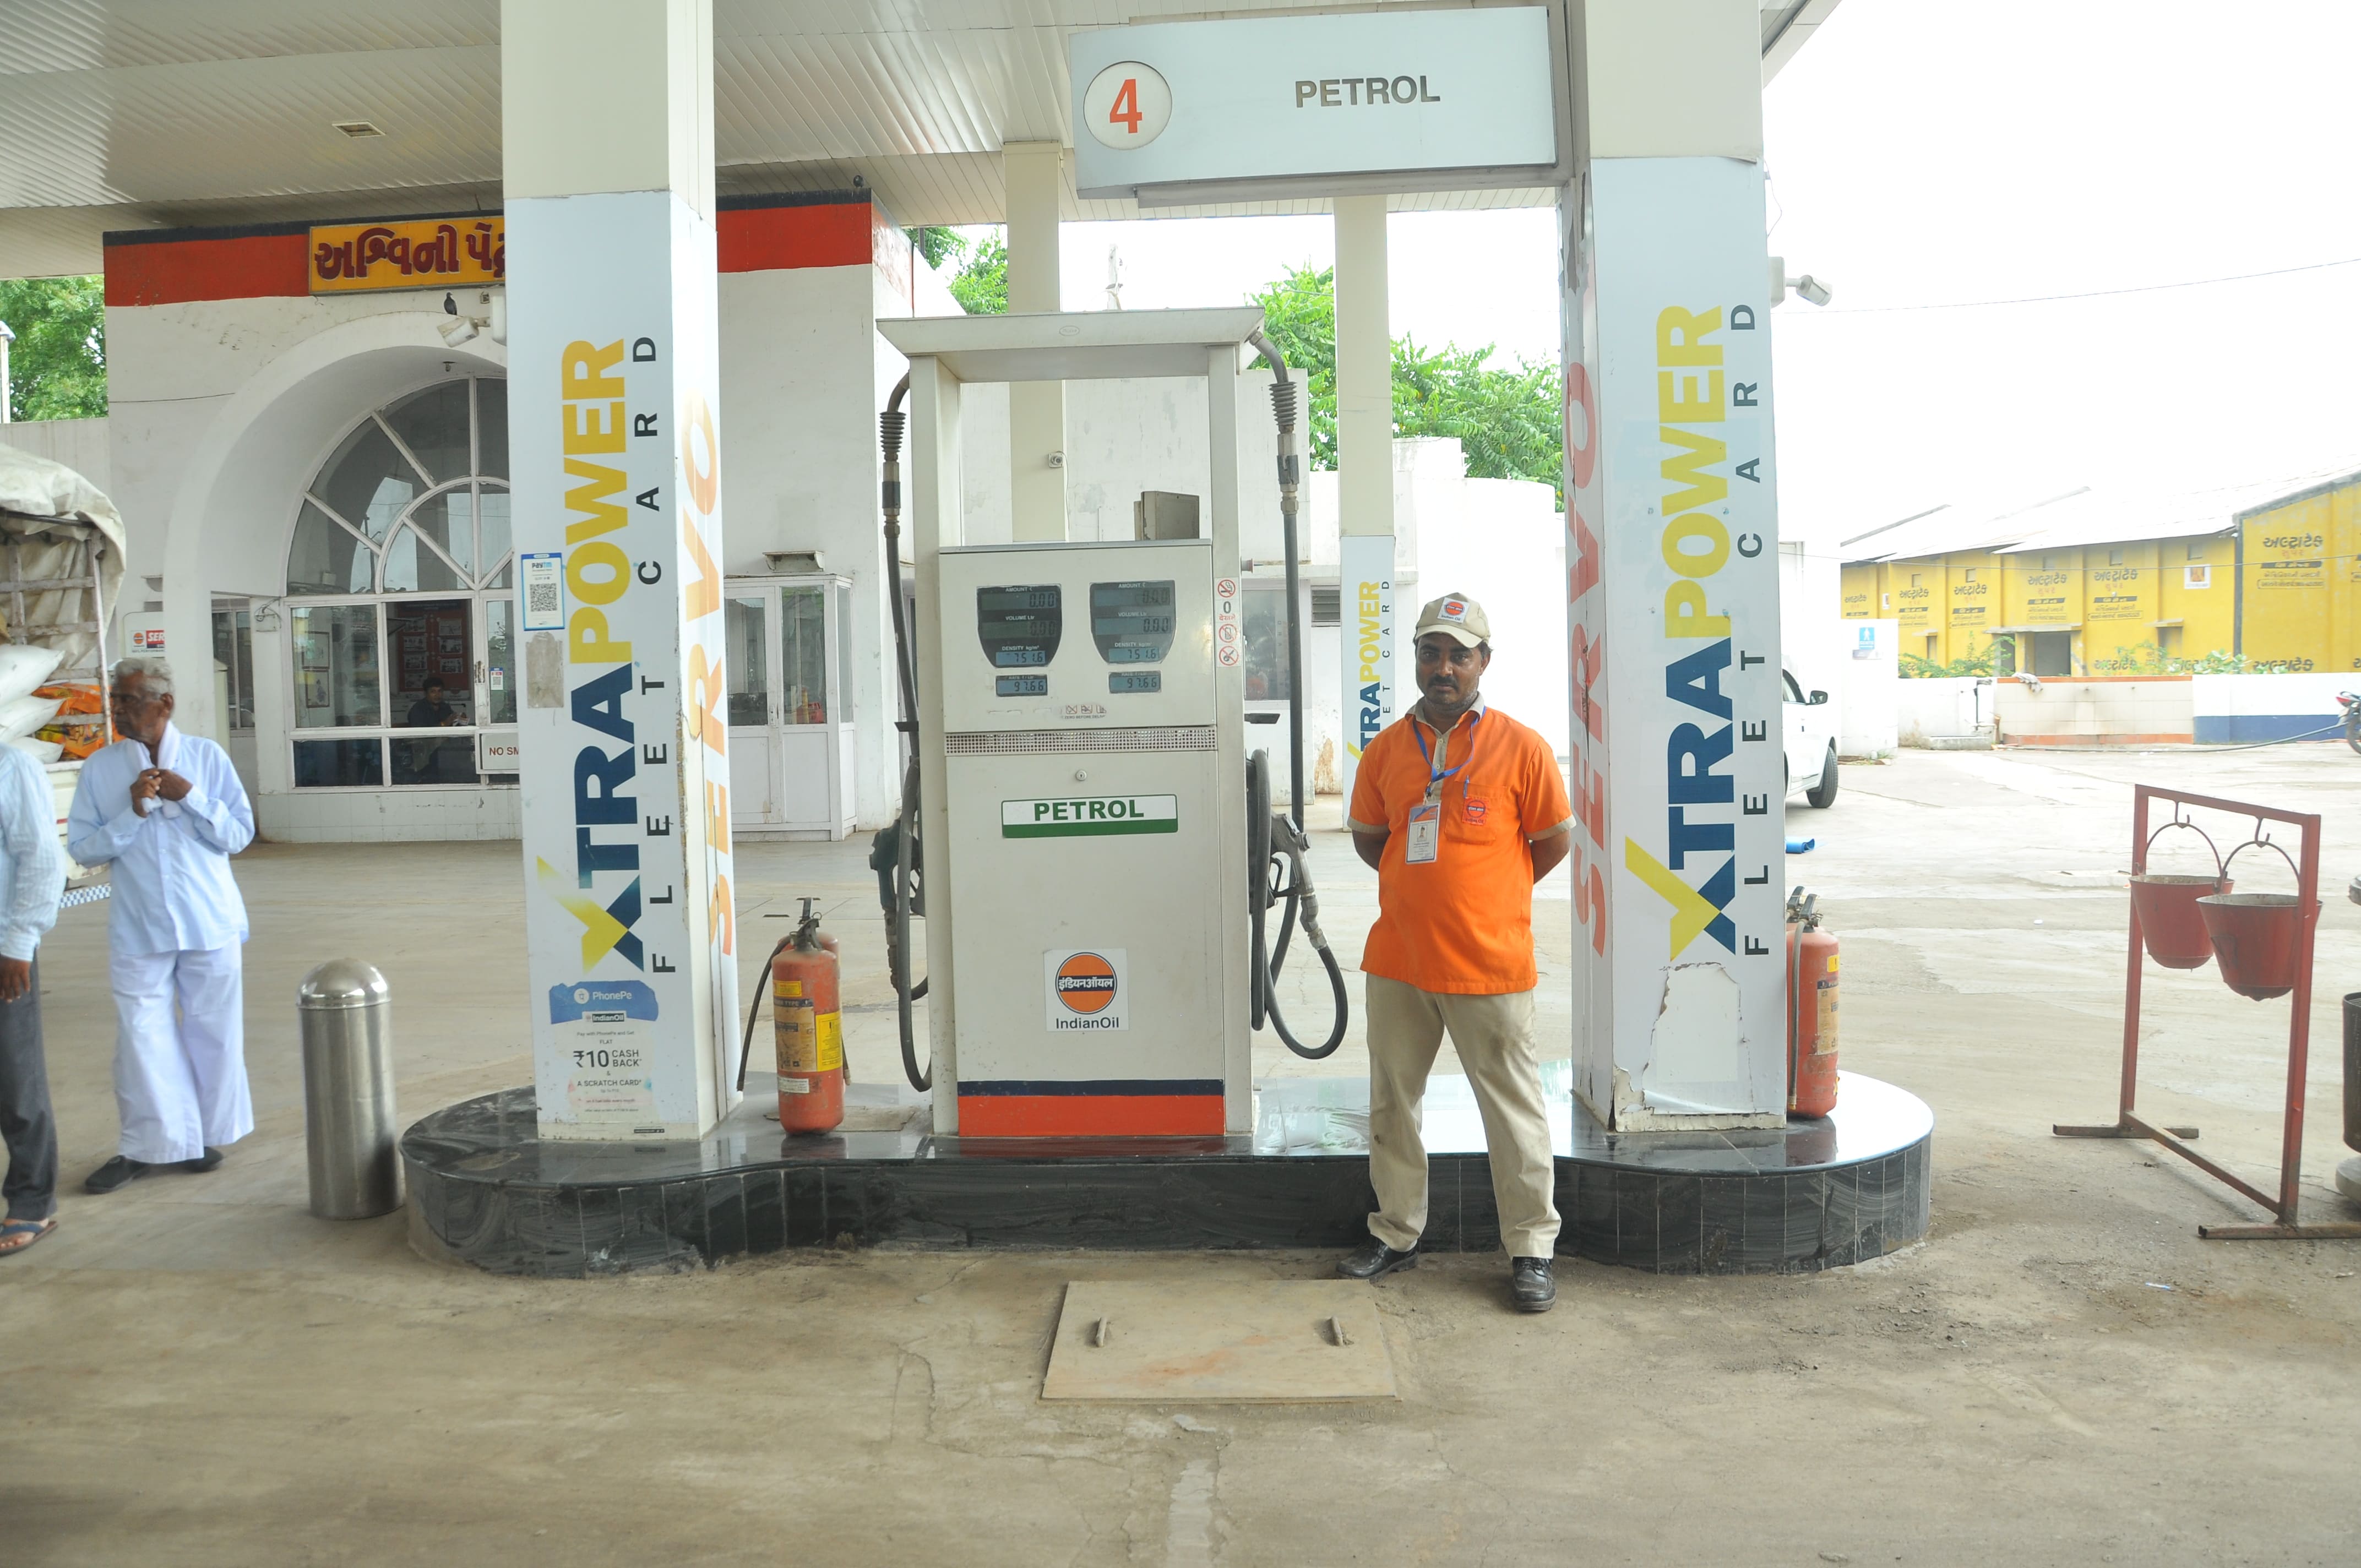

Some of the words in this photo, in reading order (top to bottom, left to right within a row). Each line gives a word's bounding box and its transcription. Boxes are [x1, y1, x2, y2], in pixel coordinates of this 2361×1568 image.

[1295, 75, 1440, 108] PETROL
[1109, 79, 1144, 134] 4
[1223, 601, 1231, 613] 0
[148, 633, 164, 641] SER
[1566, 362, 1606, 958] SERVO
[1353, 581, 1380, 758] TRAPOWER
[1014, 681, 1044, 692] 97.66
[1127, 677, 1157, 688] 97.66
[489, 747, 504, 756] NO
[1034, 799, 1144, 821] PETROL
[592, 991, 632, 1000] PhonePe
[1056, 1017, 1119, 1029] IndianOil
[573, 1050, 609, 1068] ₹10
[612, 1049, 639, 1058] CASH
